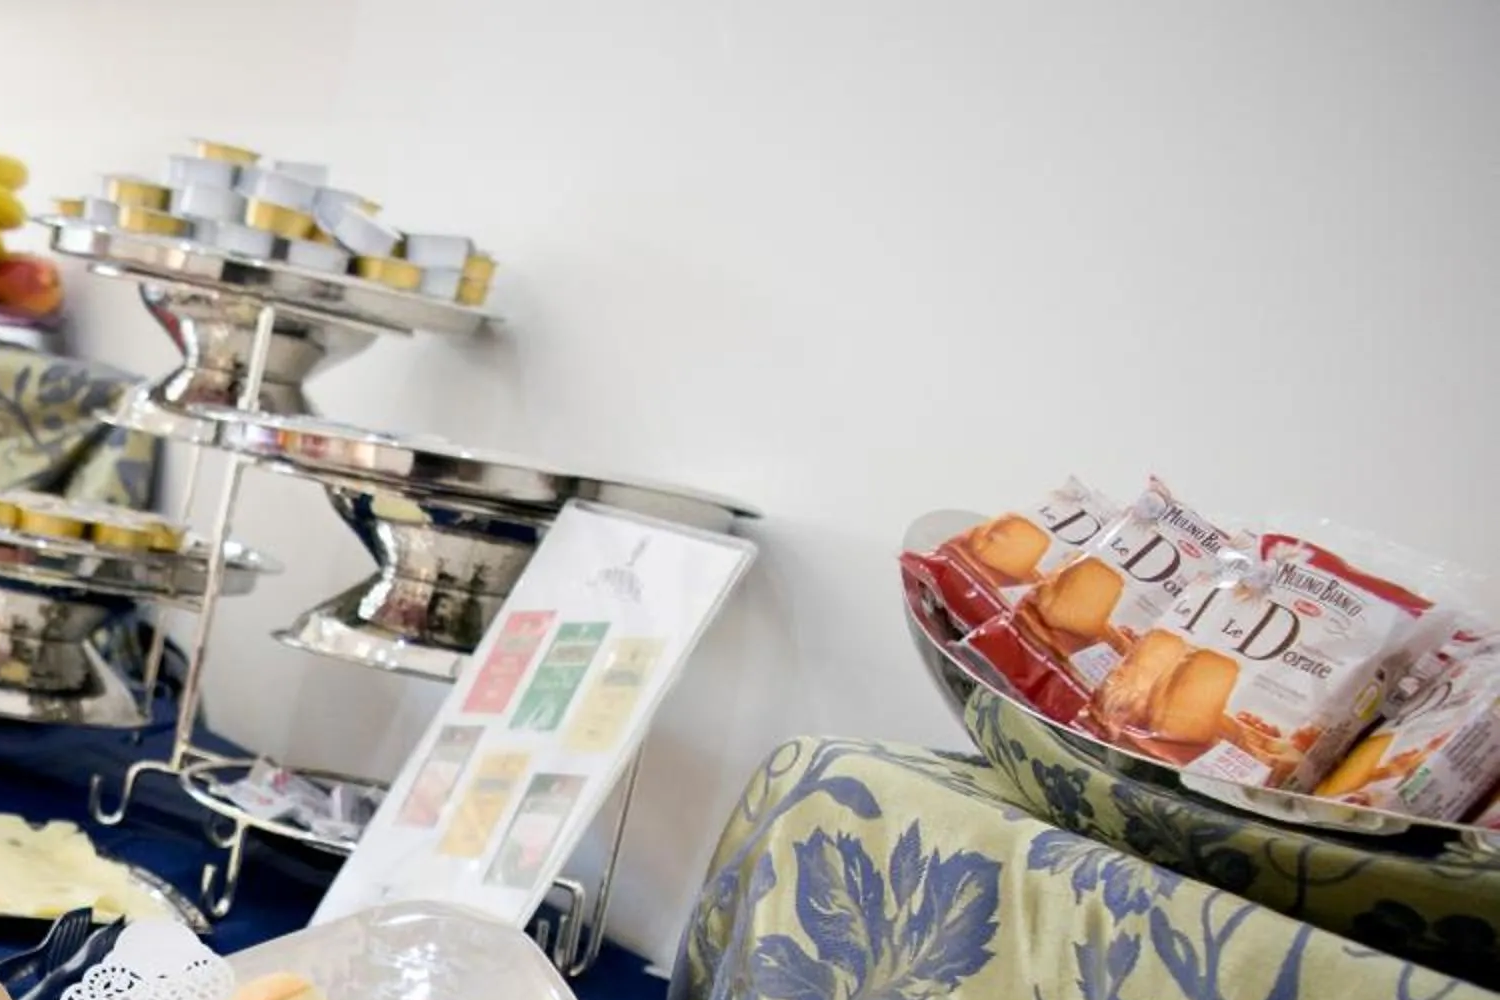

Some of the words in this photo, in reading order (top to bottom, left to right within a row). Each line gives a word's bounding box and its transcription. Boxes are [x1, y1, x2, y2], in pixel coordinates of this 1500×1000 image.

[1111, 537, 1129, 555] Le
[1222, 618, 1243, 638] Le
[1231, 600, 1332, 678] Dorate
